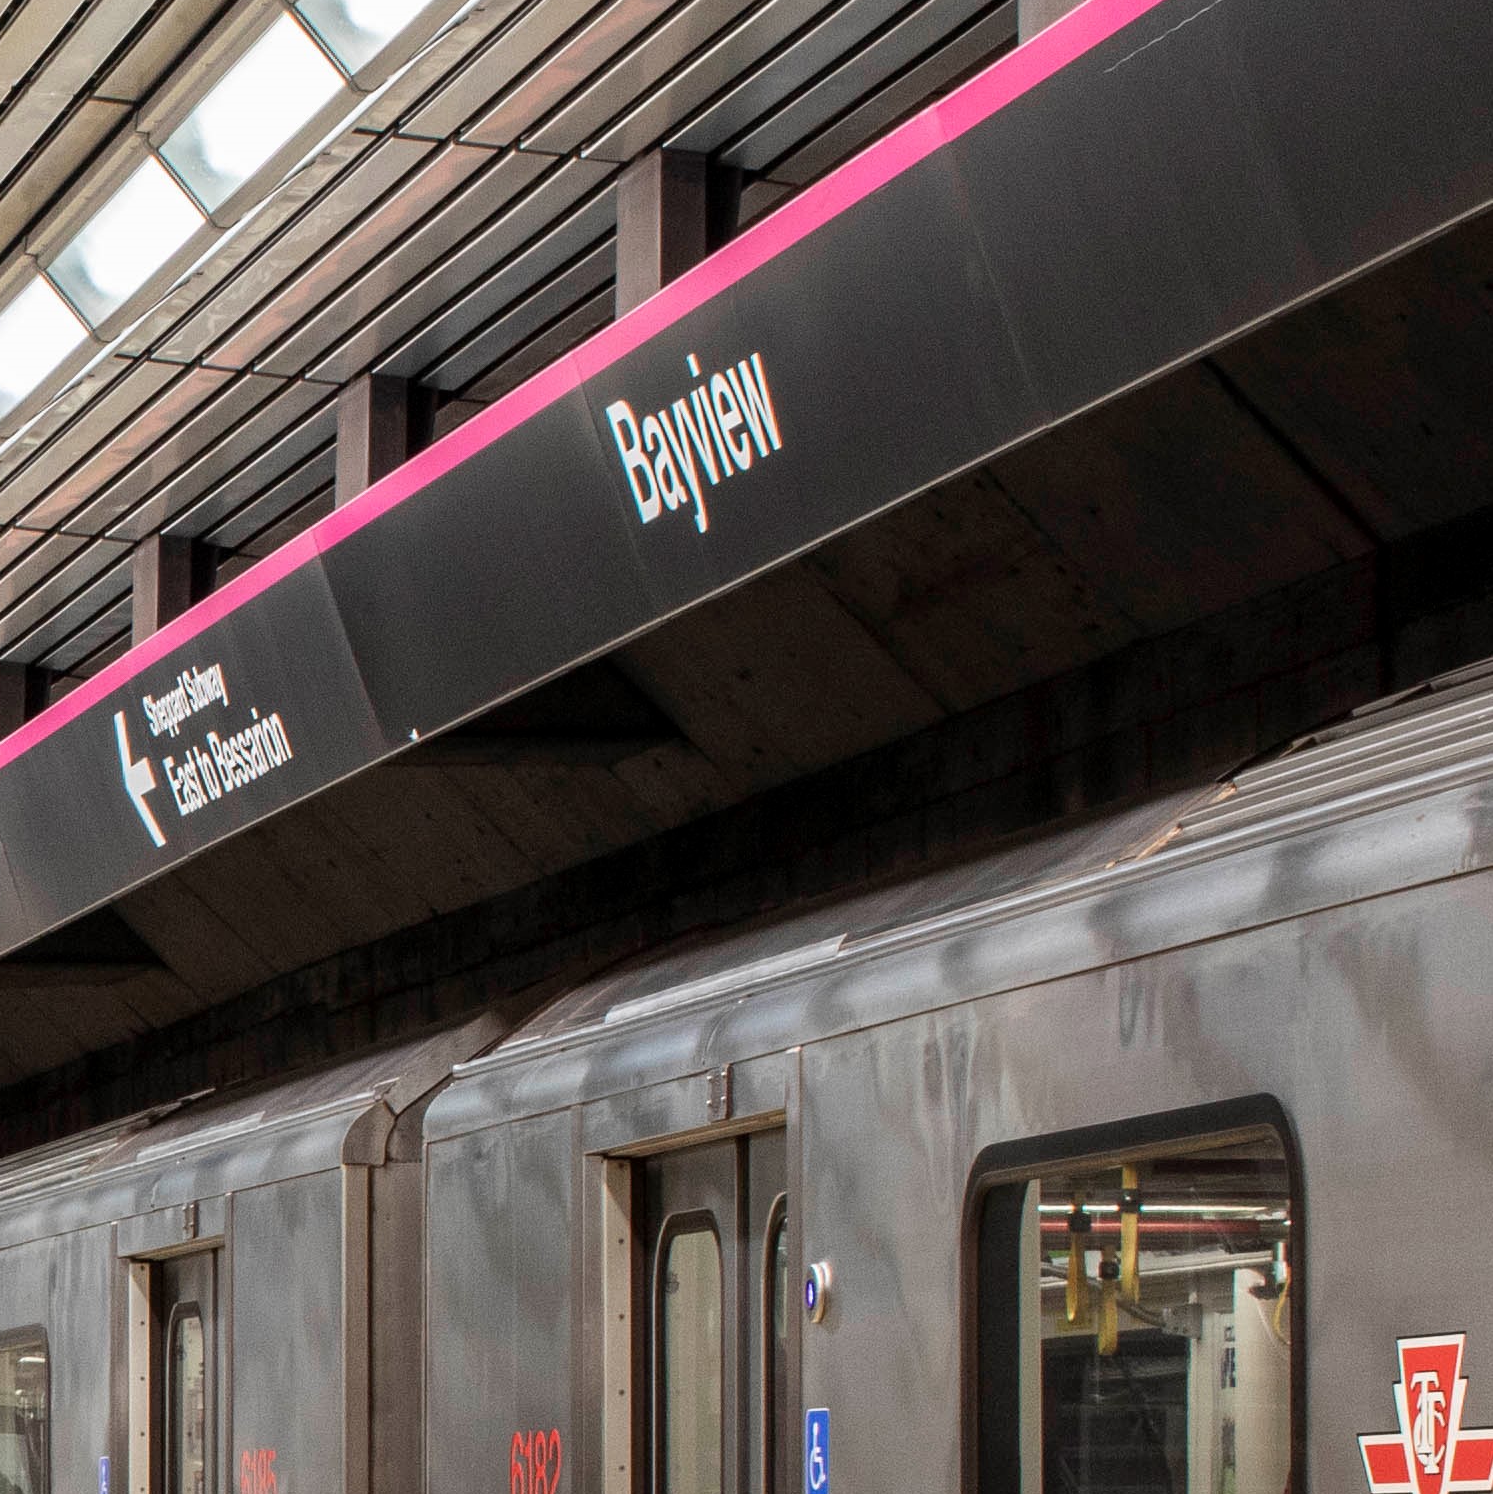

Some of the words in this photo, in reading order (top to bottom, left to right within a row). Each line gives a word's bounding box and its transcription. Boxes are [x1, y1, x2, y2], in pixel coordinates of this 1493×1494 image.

[605, 353, 783, 534] Bayview
[142, 675, 192, 738] Sheppard
[182, 663, 230, 712] Subway
[162, 747, 208, 816] East
[193, 746, 222, 801] to
[206, 707, 294, 793] Bessarion
